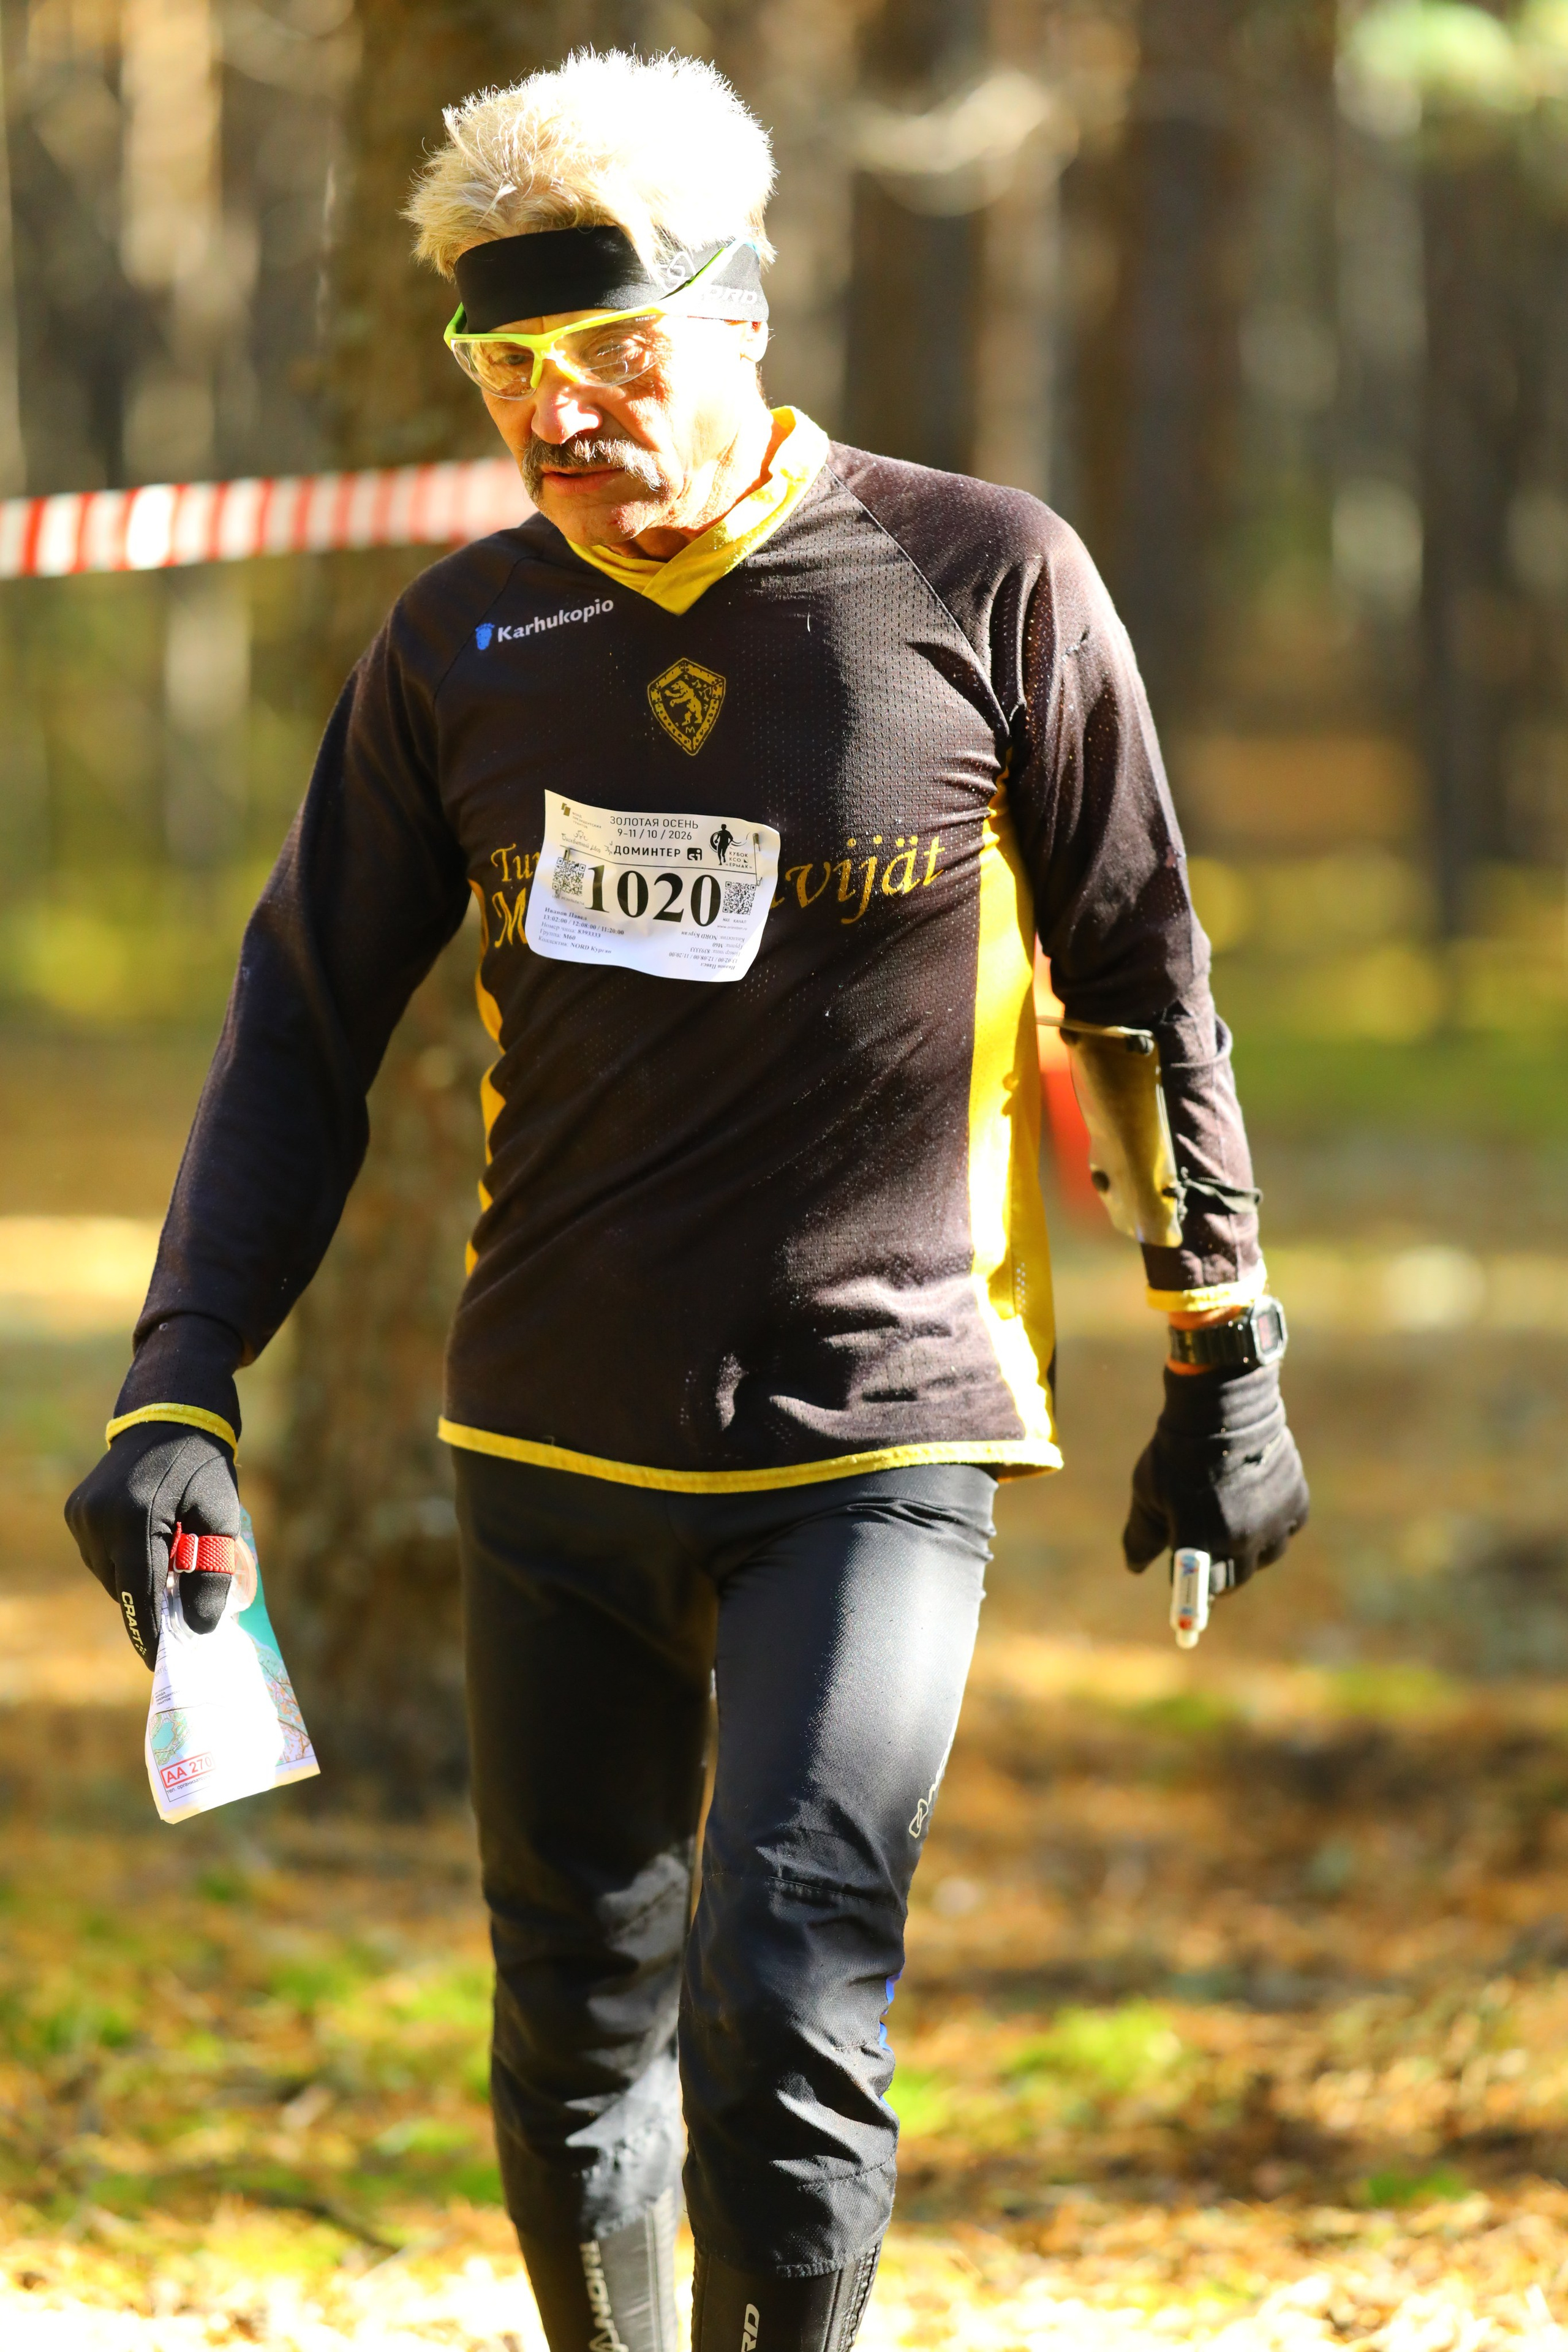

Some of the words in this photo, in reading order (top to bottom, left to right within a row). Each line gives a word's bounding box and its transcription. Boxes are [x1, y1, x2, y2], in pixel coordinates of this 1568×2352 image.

[498, 598, 613, 643] Karhukopio
[609, 816, 659, 827] ЗОЛОТАЯ
[663, 819, 699, 829] ОСЕНЬ
[647, 829, 657, 839] 10
[669, 830, 692, 840] 2026
[614, 845, 680, 857] ДОМИНТЕР
[770, 835, 945, 925] vijät
[585, 864, 722, 927] 1020
[545, 907, 567, 916] Иванов
[543, 914, 567, 924] 13:02:00
[573, 920, 596, 930] 12:08:00
[601, 926, 624, 935] 11:20:00
[122, 1591, 143, 1646] CRAFT
[189, 1757, 212, 1773] 270
